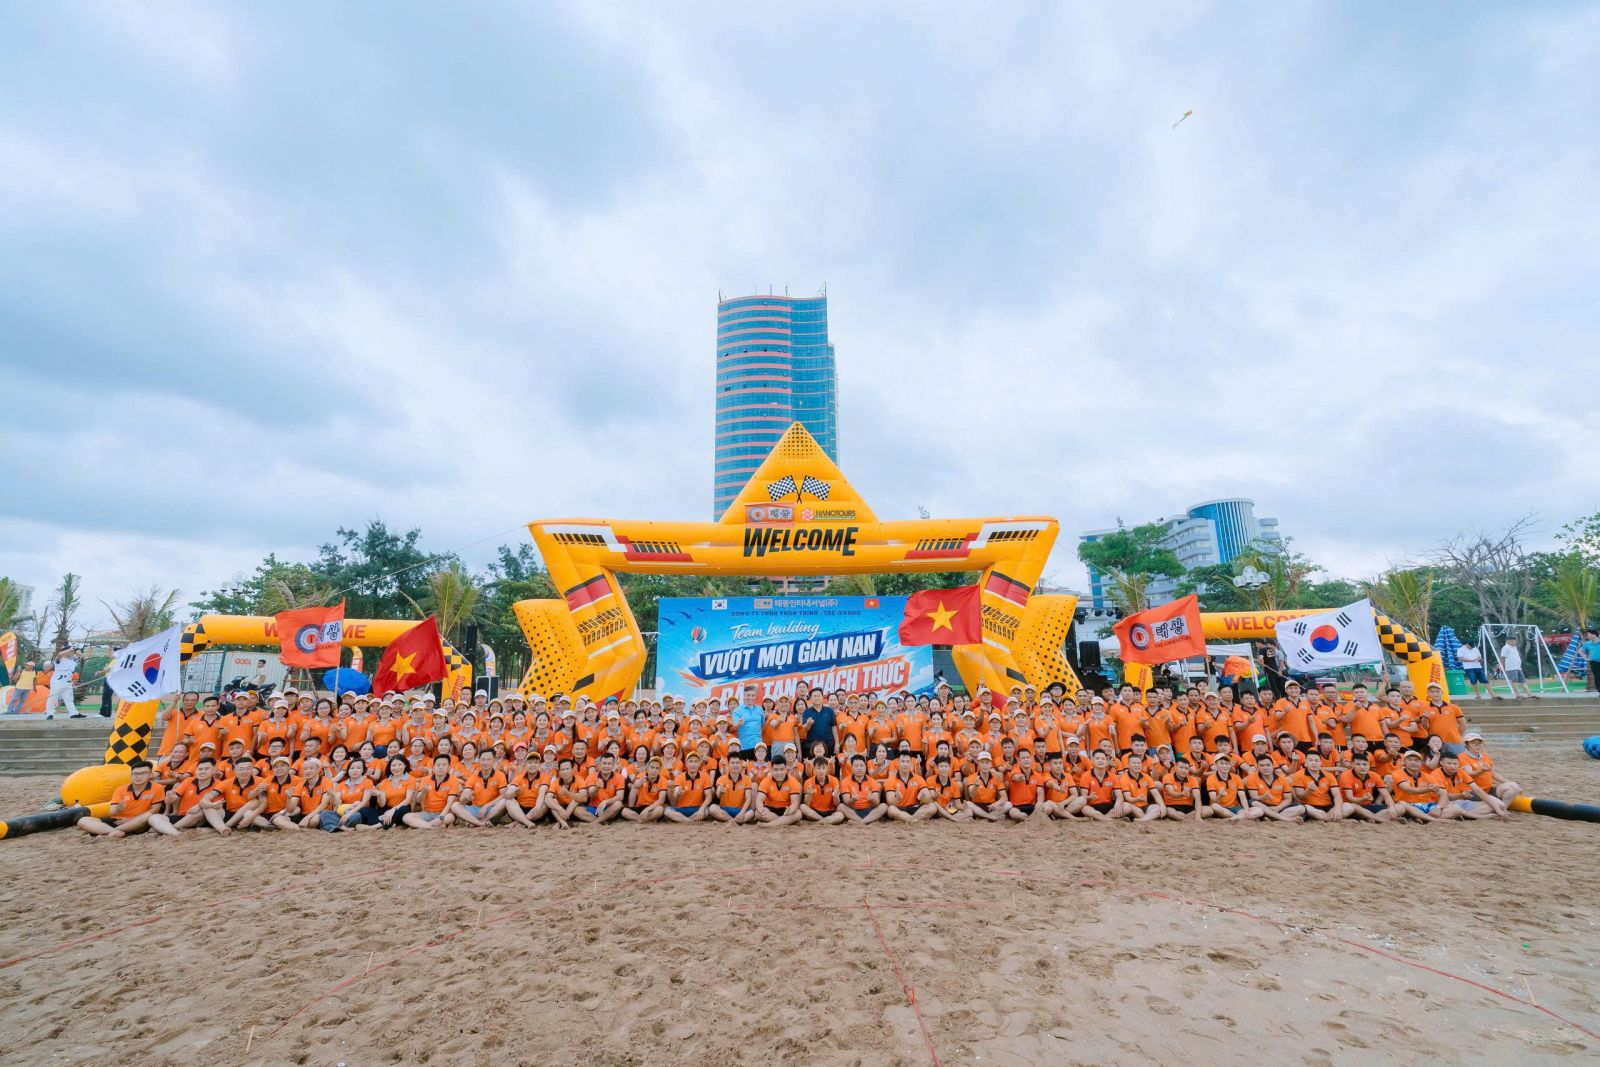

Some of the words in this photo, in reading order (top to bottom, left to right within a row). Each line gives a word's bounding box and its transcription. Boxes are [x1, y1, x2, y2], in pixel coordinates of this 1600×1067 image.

[743, 527, 859, 557] WELCOME
[729, 624, 763, 641] Team
[766, 620, 820, 641] building
[705, 649, 755, 676] VƯỢT
[757, 643, 795, 670] MỌI
[797, 638, 839, 664] GIAN
[839, 634, 877, 656] NAN
[763, 678, 798, 702] TAN
[862, 660, 905, 689] THỨC
